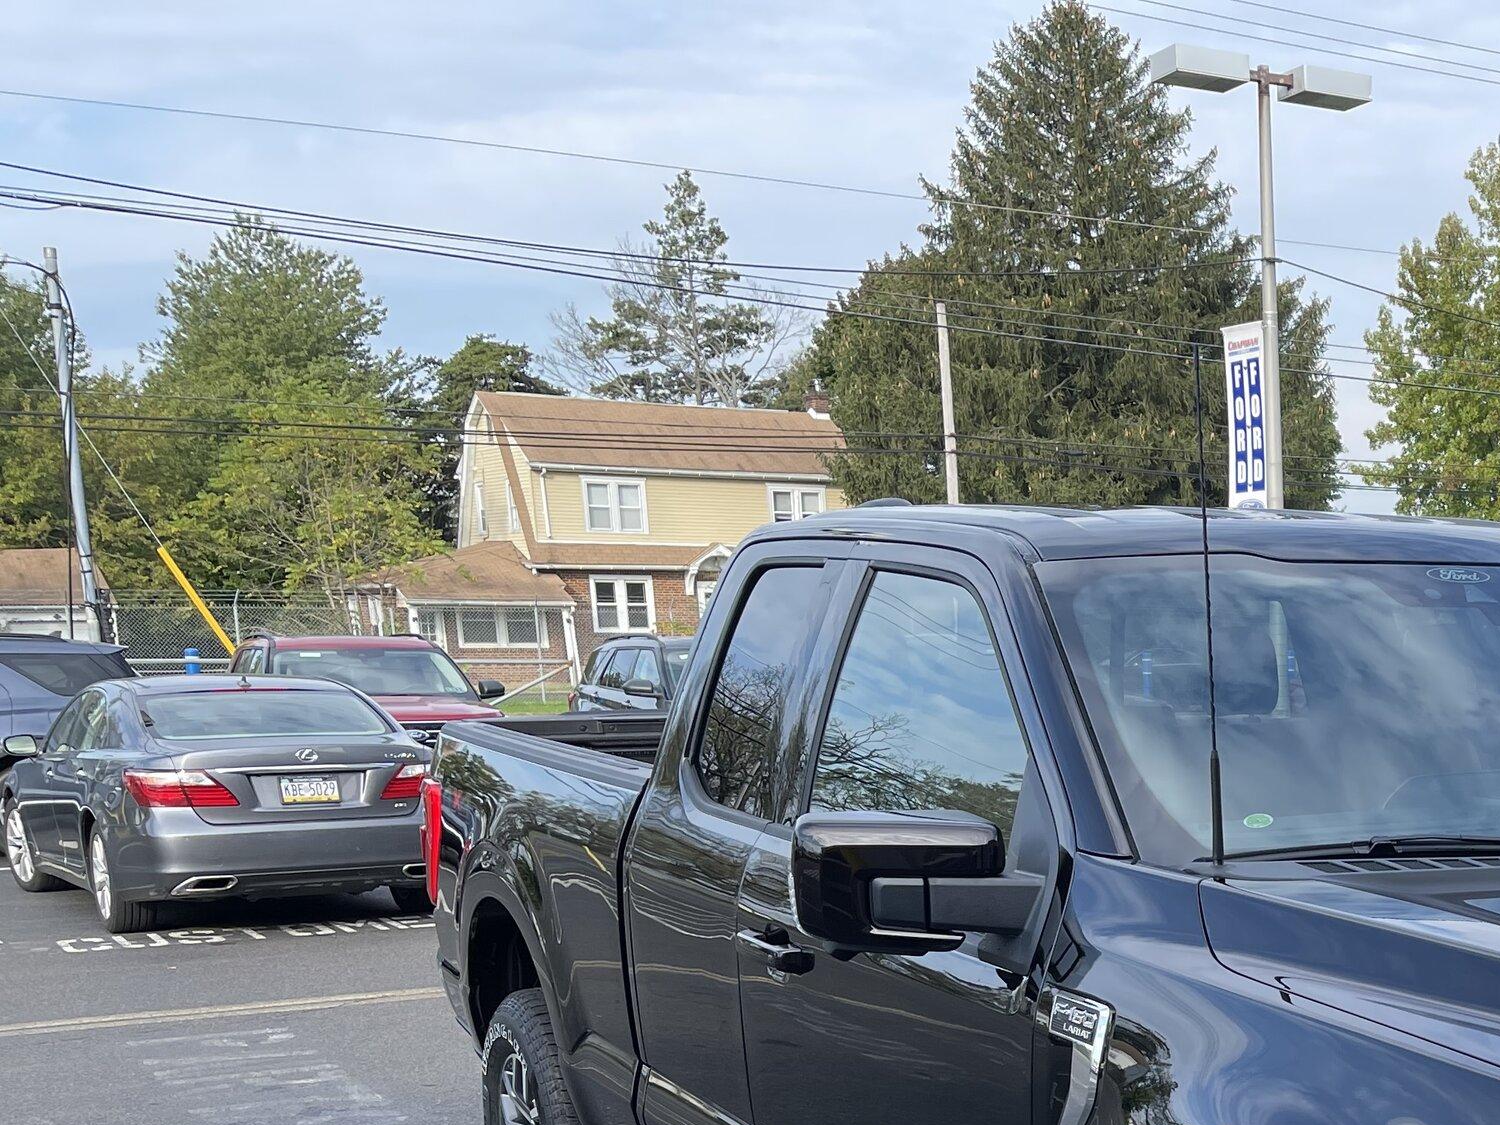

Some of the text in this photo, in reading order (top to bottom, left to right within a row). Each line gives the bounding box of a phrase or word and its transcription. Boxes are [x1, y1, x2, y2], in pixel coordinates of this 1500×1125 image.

[1234, 364, 1247, 484] FORD
[1250, 361, 1263, 482] FORD
[1440, 569, 1480, 581] Ford
[284, 782, 335, 797] KBE 5029
[57, 914, 436, 953] CUSTOME
[1063, 1022, 1091, 1039] LARIAT
